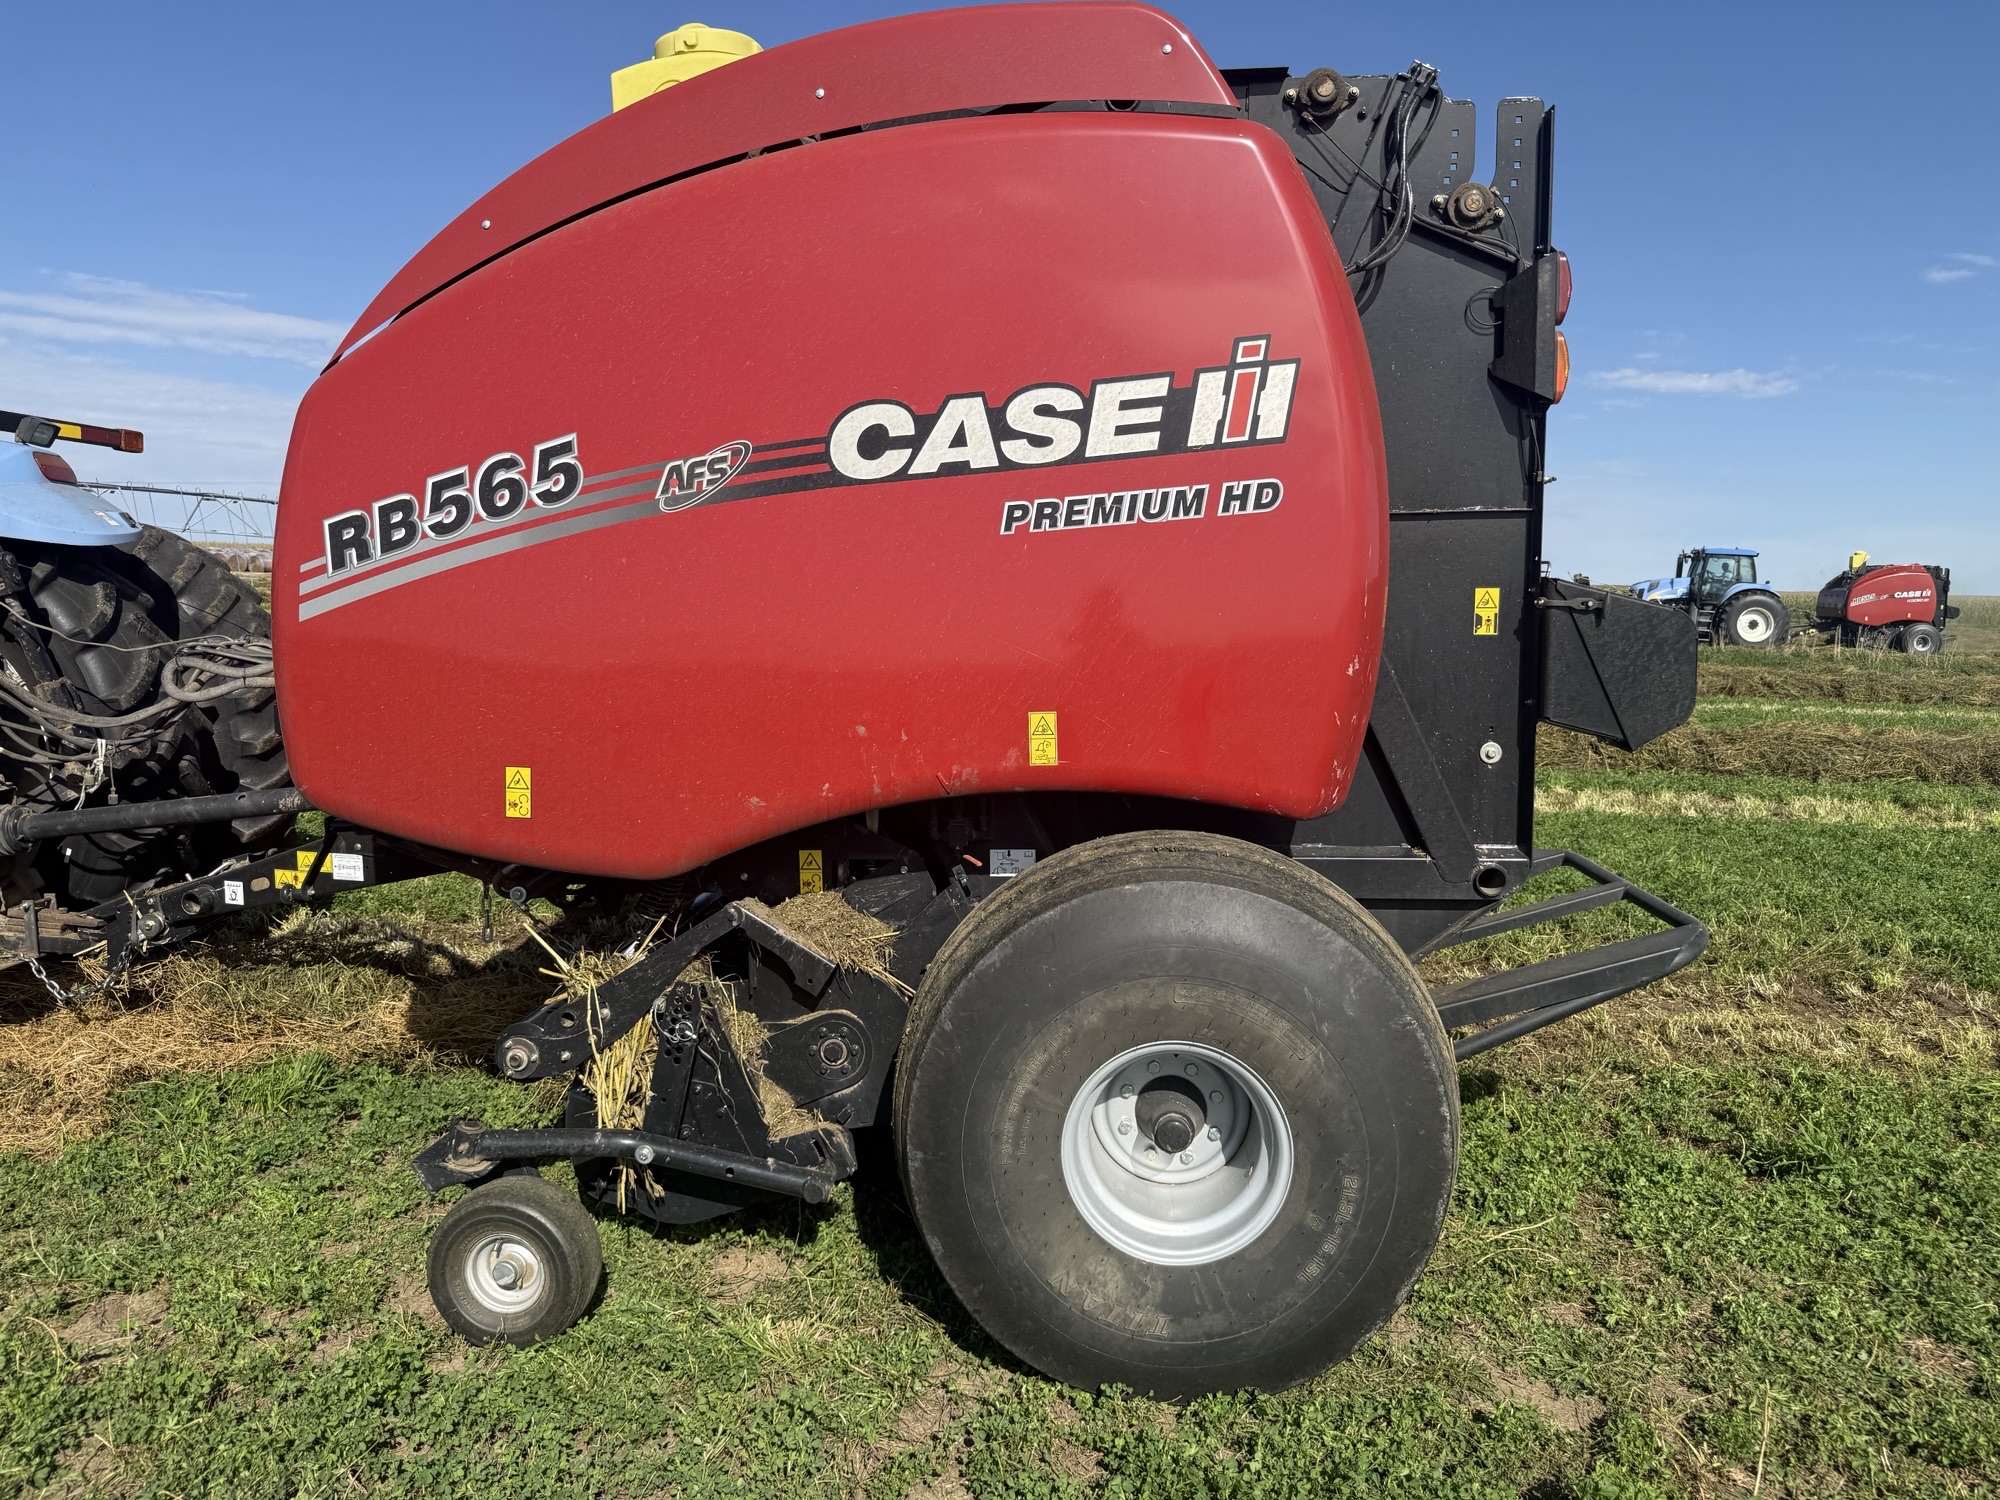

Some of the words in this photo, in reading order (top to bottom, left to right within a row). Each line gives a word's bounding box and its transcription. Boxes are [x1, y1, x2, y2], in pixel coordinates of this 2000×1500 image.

[829, 377, 1171, 480] CASE
[323, 432, 584, 577] RB565
[655, 451, 732, 499] AFS
[1000, 484, 1208, 534] PREMIUM
[1217, 478, 1284, 516] HD
[1047, 1269, 1170, 1339] TITAN
